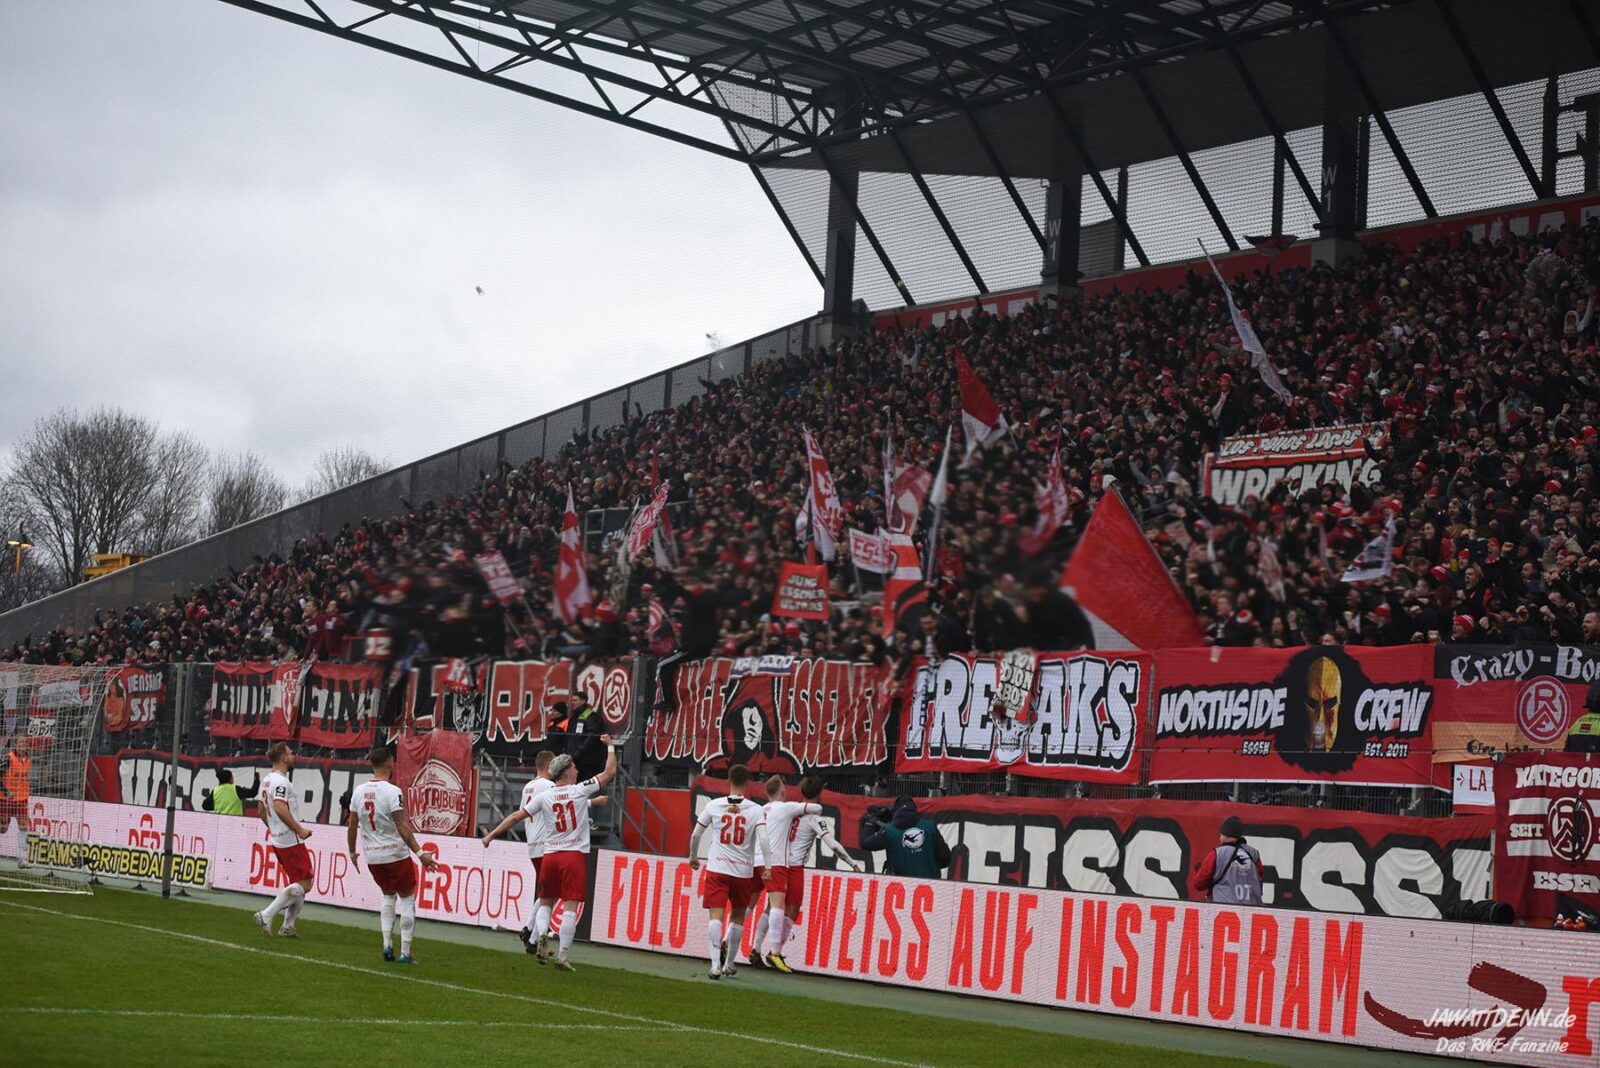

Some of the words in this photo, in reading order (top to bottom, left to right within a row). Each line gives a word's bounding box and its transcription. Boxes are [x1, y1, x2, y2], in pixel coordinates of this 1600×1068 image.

[1555, 644, 1600, 683] Bo
[1157, 687, 1288, 735] NORTHSIDE
[1354, 687, 1431, 733] CREW
[1242, 740, 1270, 757] ESSEN
[1386, 743, 1409, 758] 2011
[363, 801, 377, 832] 7
[551, 799, 578, 834] 31
[719, 813, 747, 846] 26
[1509, 822, 1545, 838] SEIT
[26, 834, 208, 886] TEAMSPORTBEDAF.DE
[1234, 884, 1252, 901] 07
[947, 888, 1038, 995] AUF
[1056, 896, 1364, 1038] INSTAGRAM
